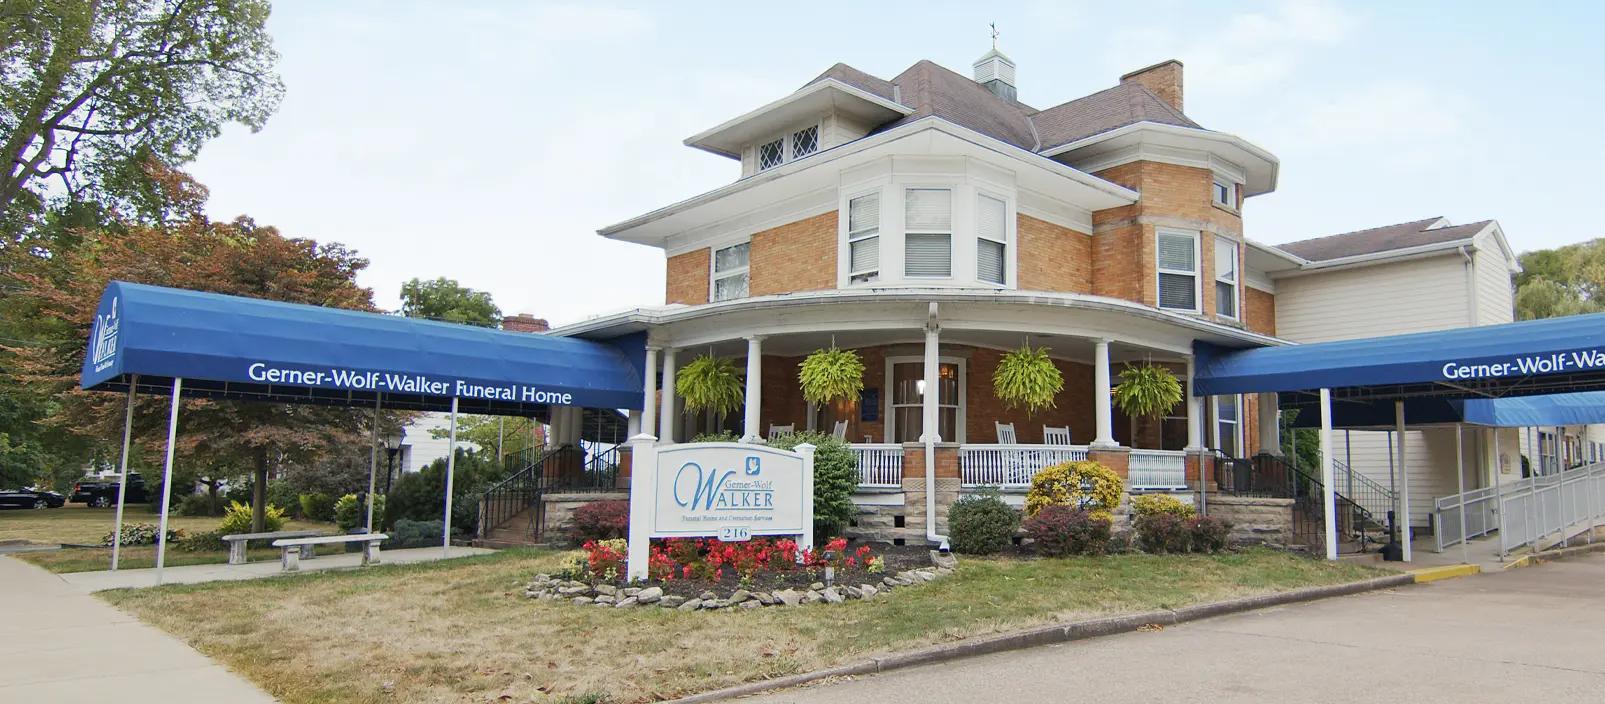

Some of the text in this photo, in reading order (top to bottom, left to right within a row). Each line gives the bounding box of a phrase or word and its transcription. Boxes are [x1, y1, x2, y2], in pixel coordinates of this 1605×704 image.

[248, 362, 572, 405] Gerner-Wolf-Walker Funeral Home
[674, 462, 773, 511] WALKER
[725, 480, 773, 489] Gerner-Wolf
[682, 514, 701, 522] Funeral
[724, 528, 748, 539] 216
